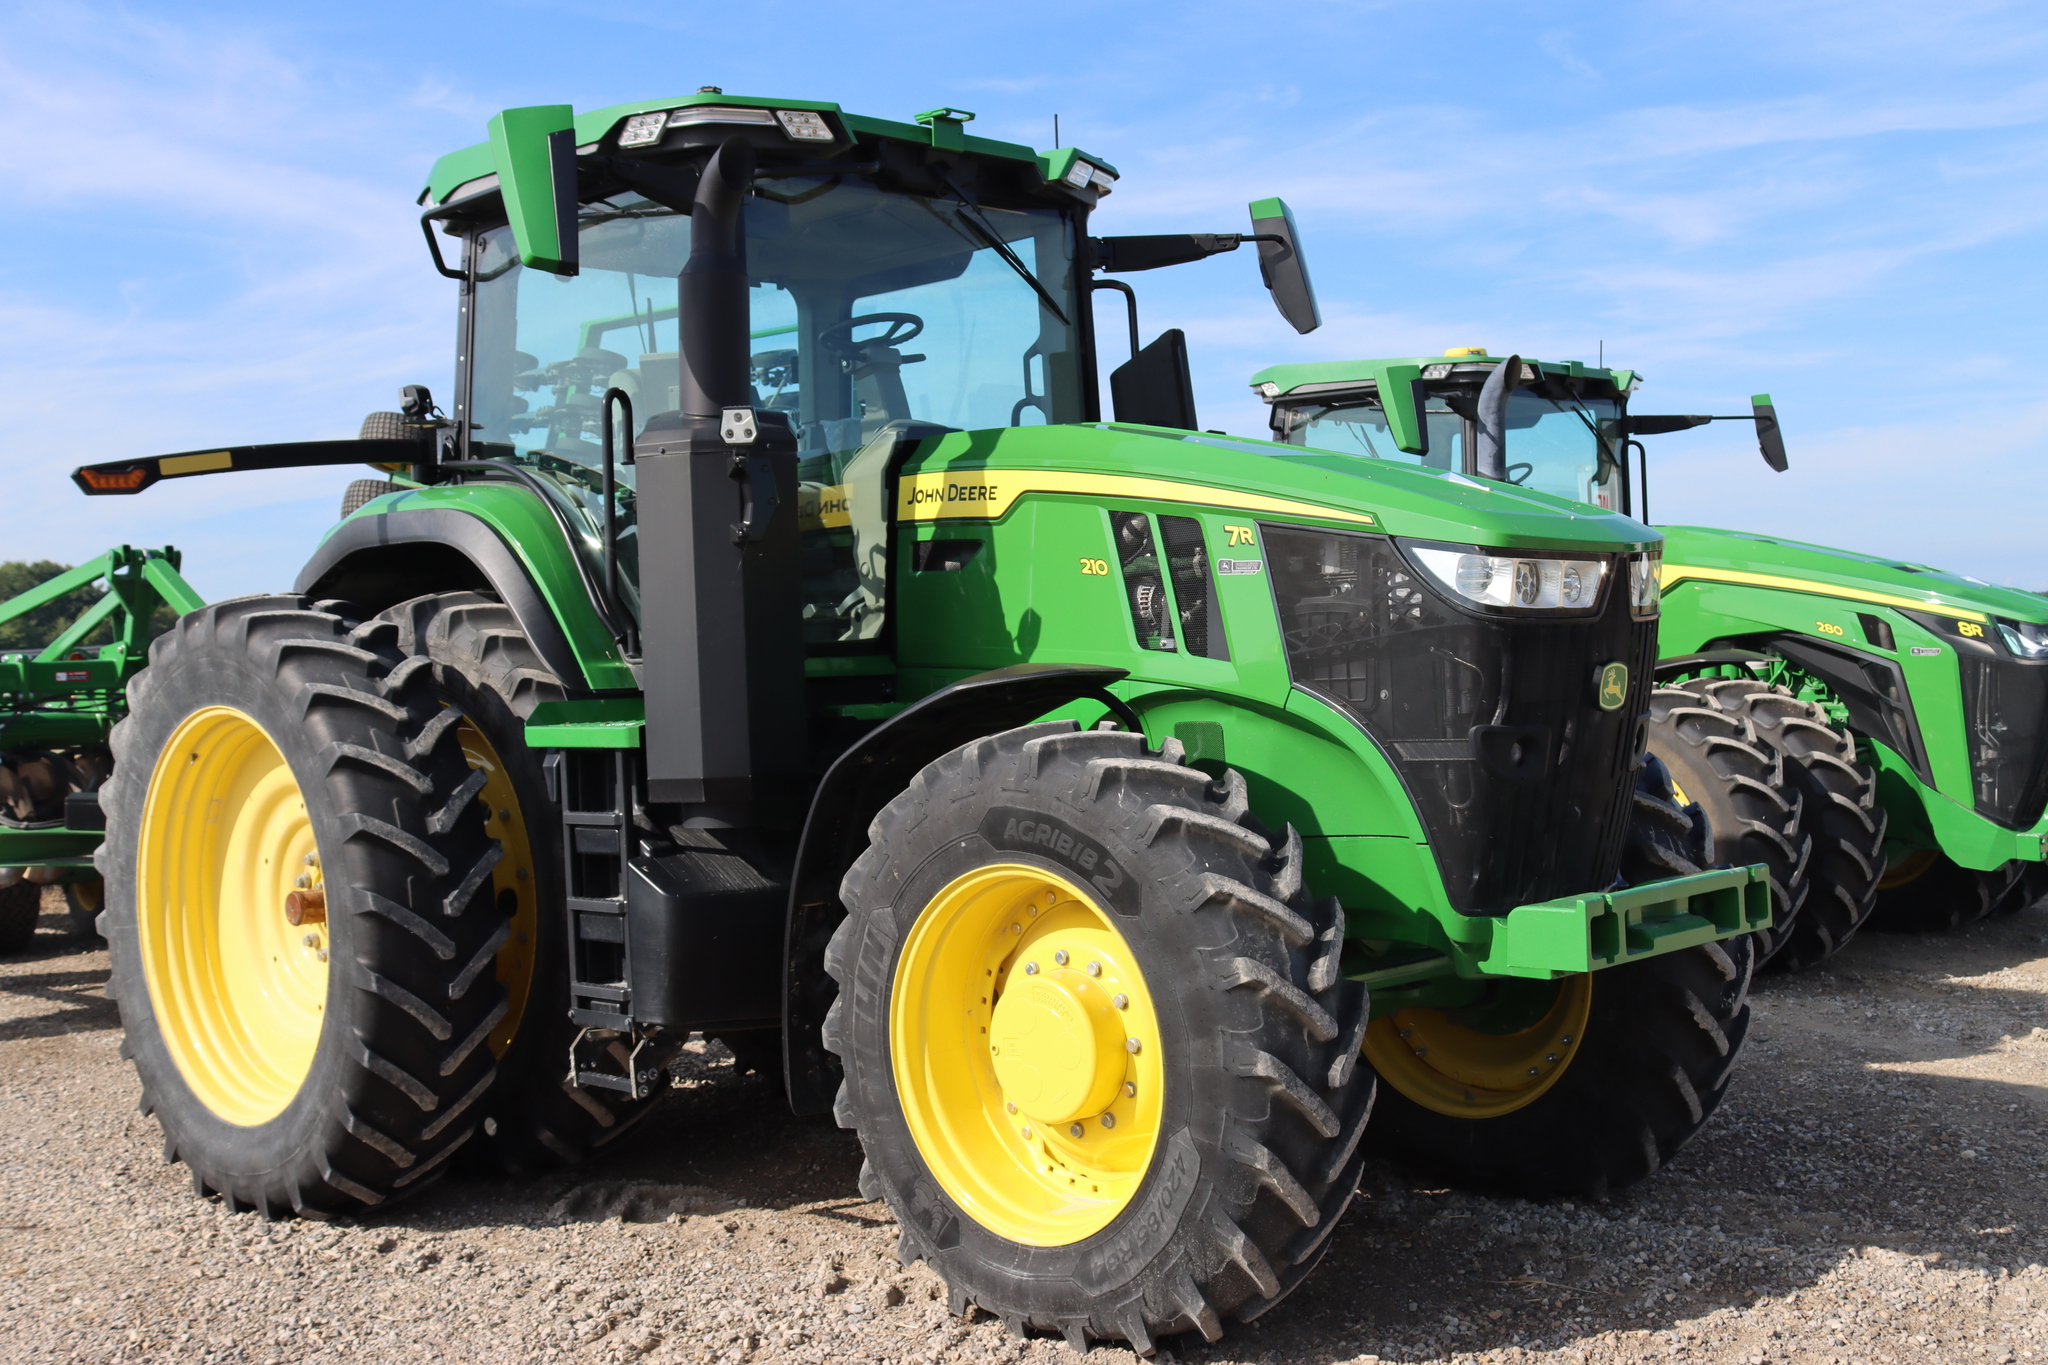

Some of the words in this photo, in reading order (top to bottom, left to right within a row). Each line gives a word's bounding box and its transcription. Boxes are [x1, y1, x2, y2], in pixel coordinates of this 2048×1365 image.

[907, 486, 944, 505] JOHN
[947, 483, 998, 502] DEERE
[1223, 525, 1255, 547] 7R
[1079, 558, 1109, 576] 210
[1816, 621, 1844, 636] 280
[1957, 621, 1984, 638] 8R
[1003, 818, 1099, 871] AGRIBIB
[1091, 858, 1123, 899] 2
